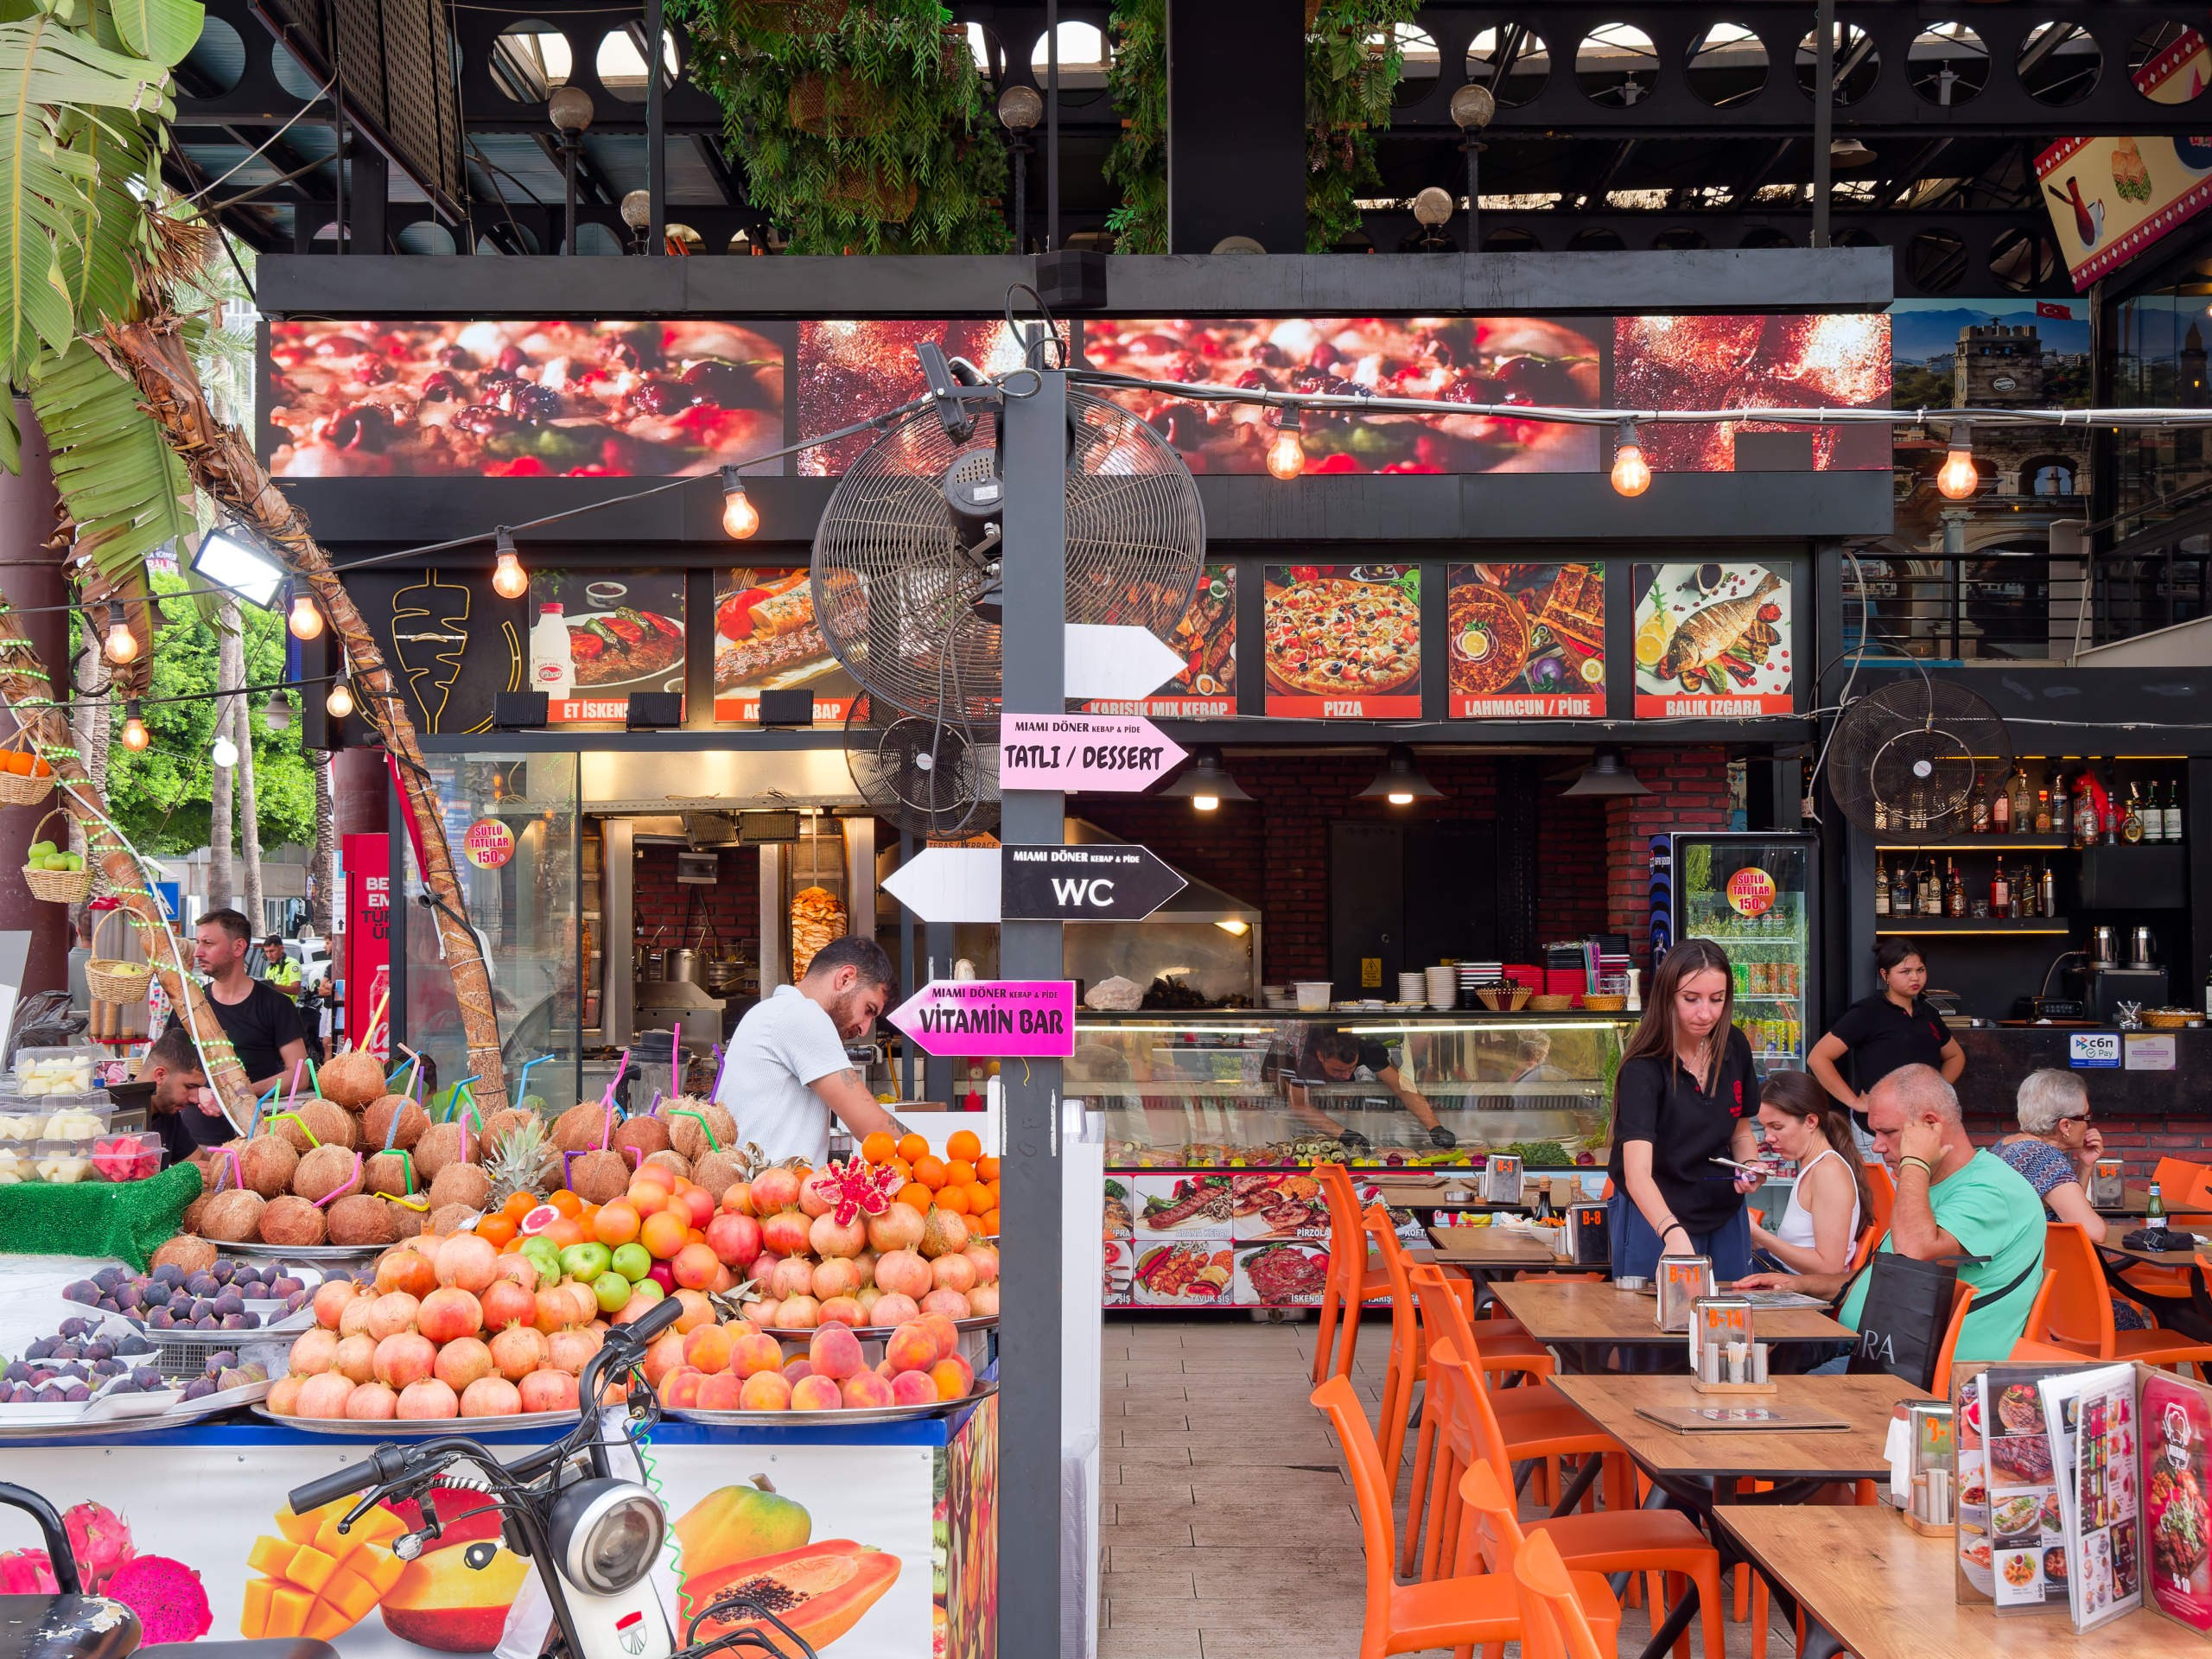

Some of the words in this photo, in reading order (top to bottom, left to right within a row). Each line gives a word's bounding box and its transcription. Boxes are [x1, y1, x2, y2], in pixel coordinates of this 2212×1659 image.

[564, 702, 580, 718] ET
[813, 703, 841, 719] BAP
[1152, 702, 1179, 716] MIX
[1182, 702, 1227, 716] KEBAP
[1324, 701, 1363, 716] PIZZA
[1465, 700, 1544, 716] LAHMACUN
[1548, 700, 1554, 715] /
[1558, 696, 1590, 715] PİDE
[1666, 700, 1707, 715] BALIK
[1711, 700, 1761, 715] IZGARA
[1014, 721, 1048, 732] MIAMI
[1052, 720, 1089, 732] DÖNER
[1124, 724, 1141, 733] PİDE
[1004, 745, 1061, 769] TATLI
[1065, 746, 1077, 768] /
[1083, 746, 1164, 771] DESSERT
[475, 823, 503, 836] SÜTLÜ
[469, 836, 509, 849] TATLILAR
[1014, 851, 1047, 861] MIAMI
[1051, 849, 1088, 862] DÖNER
[1123, 854, 1140, 863] PİDE
[365, 877, 389, 890] BE
[1737, 872, 1764, 885] SÜTLÜ
[1051, 878, 1115, 907] WC
[1732, 886, 1770, 896] TATLILAR
[368, 893, 389, 906] EM
[931, 988, 966, 998] MIAMI
[969, 986, 1007, 998] DÖNER
[1042, 989, 1058, 998] PİDE
[919, 1003, 1013, 1034] VİTAMİN
[1019, 1009, 1064, 1034] BAR
[2089, 1038, 2113, 1048] сбп
[2098, 1049, 2113, 1058] Pay
[1497, 1160, 1513, 1173] B-3
[2100, 1166, 2116, 1177] B-4
[1582, 1211, 1601, 1225] B-8
[1296, 1227, 1331, 1237] PİRZOLA
[1669, 1265, 1700, 1283] B-11
[1189, 1294, 1216, 1304] TAVUK
[1291, 1294, 1325, 1304] İSKENDE
[1708, 1309, 1744, 1328] B-14
[1858, 1329, 1896, 1364] RA
